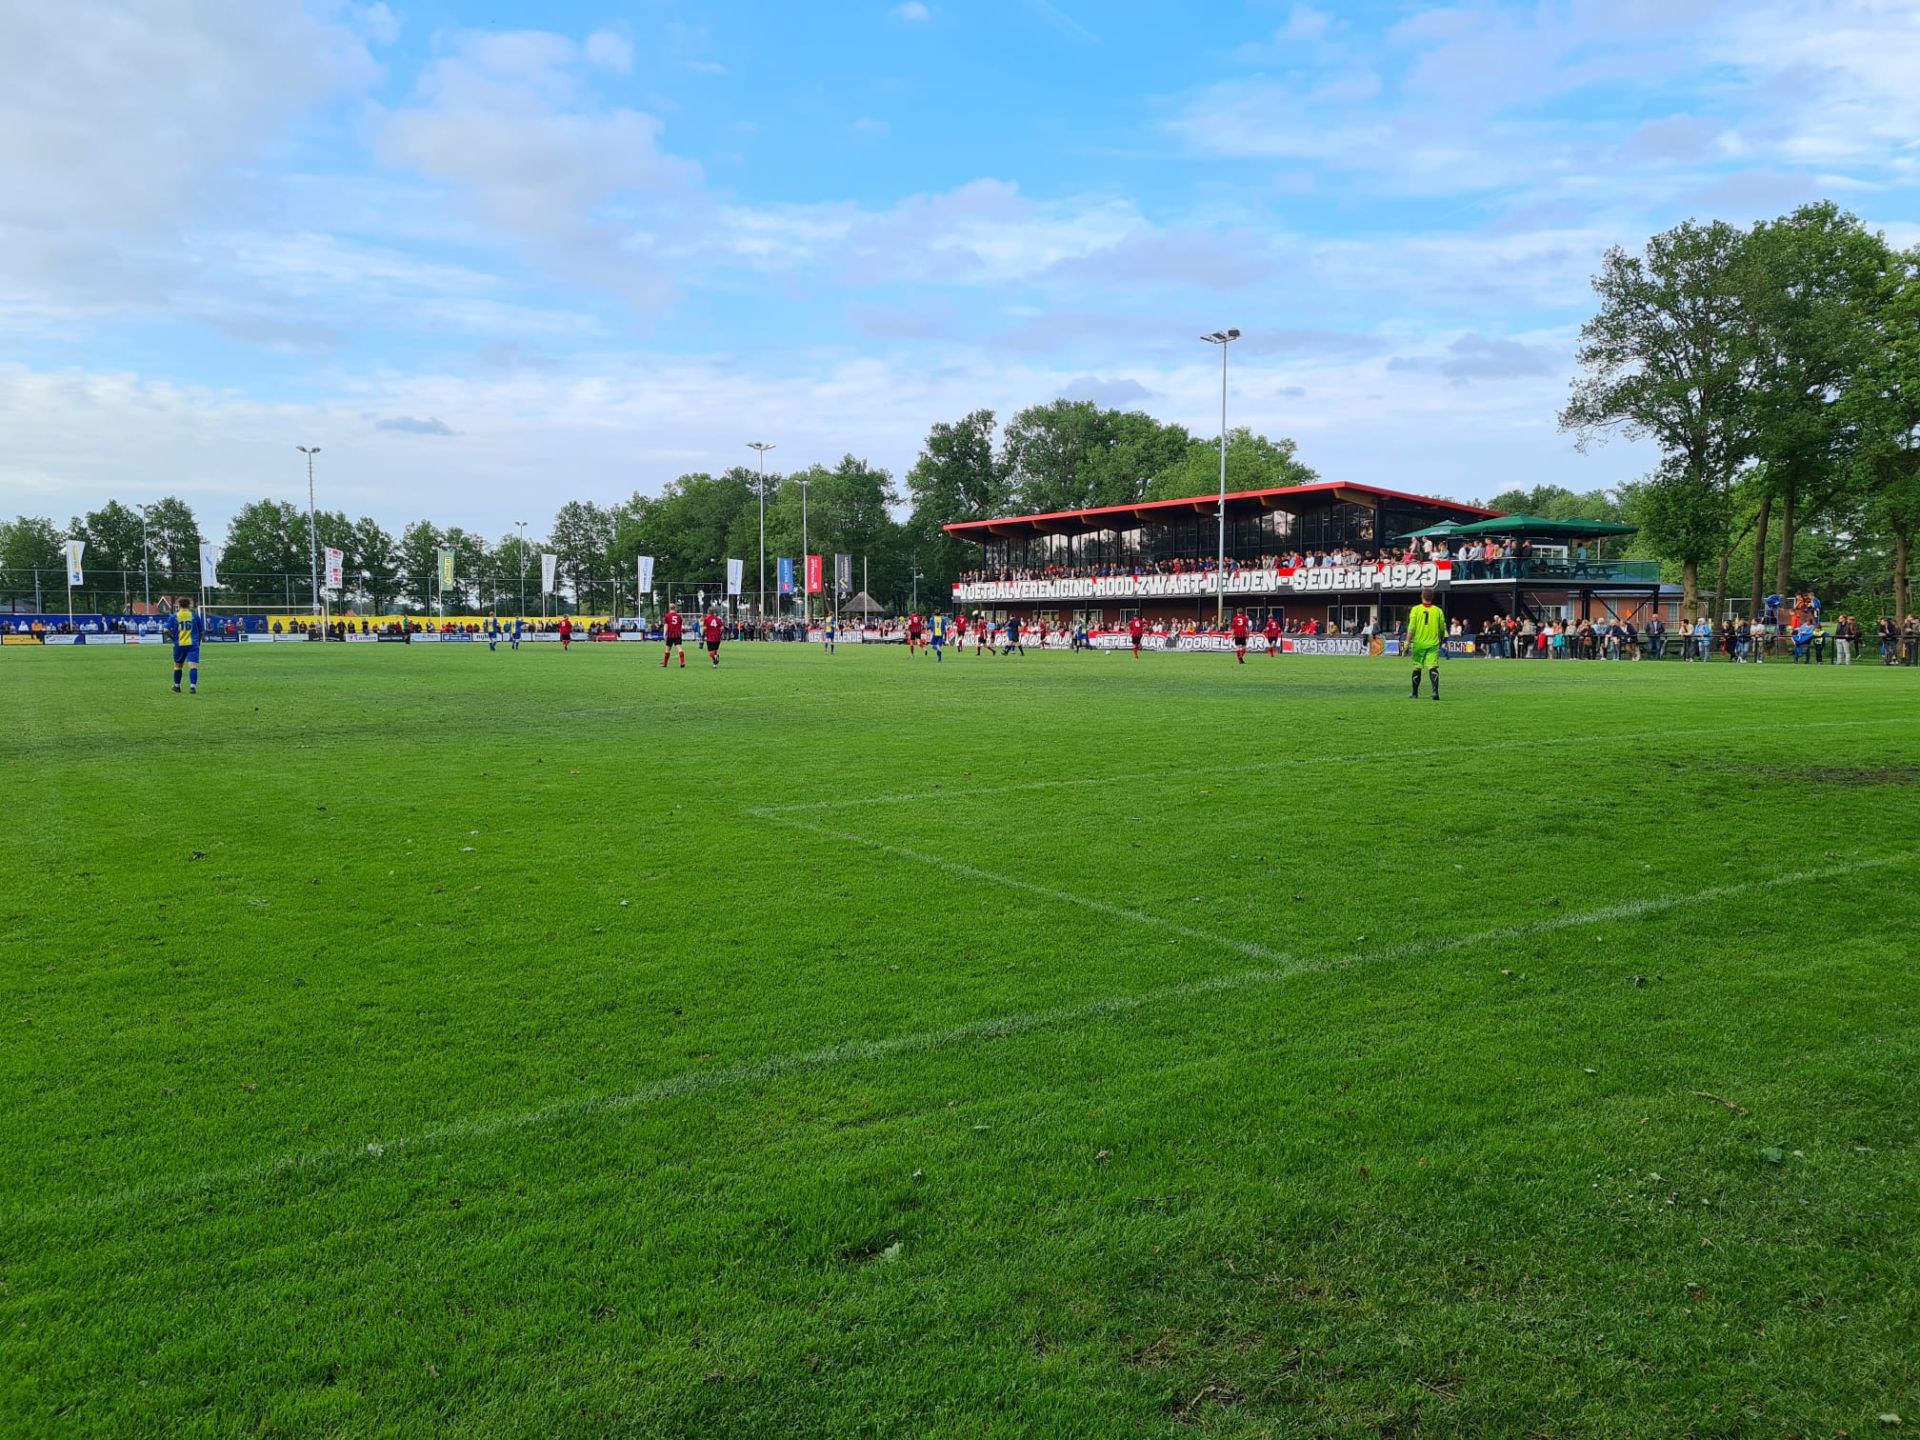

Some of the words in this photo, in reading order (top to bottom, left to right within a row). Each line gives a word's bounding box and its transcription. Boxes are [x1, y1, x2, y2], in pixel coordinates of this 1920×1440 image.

[960, 578, 1094, 600] VOETBALVERENIGING
[1096, 576, 1134, 598] ROOD
[1137, 571, 1203, 596] ZWART
[1206, 569, 1277, 593] DELDEN
[1381, 561, 1437, 589] 1923
[672, 616, 678, 625] 5
[1237, 618, 1243, 626] 3
[1423, 610, 1429, 625] 1
[180, 620, 192, 631] 16
[710, 619, 717, 627] 4
[1135, 620, 1141, 628] 6
[1097, 635, 1118, 649] MET
[1119, 635, 1166, 650] ELAAR
[1177, 635, 1210, 649] VOOR
[1212, 635, 1265, 650] ELKAR
